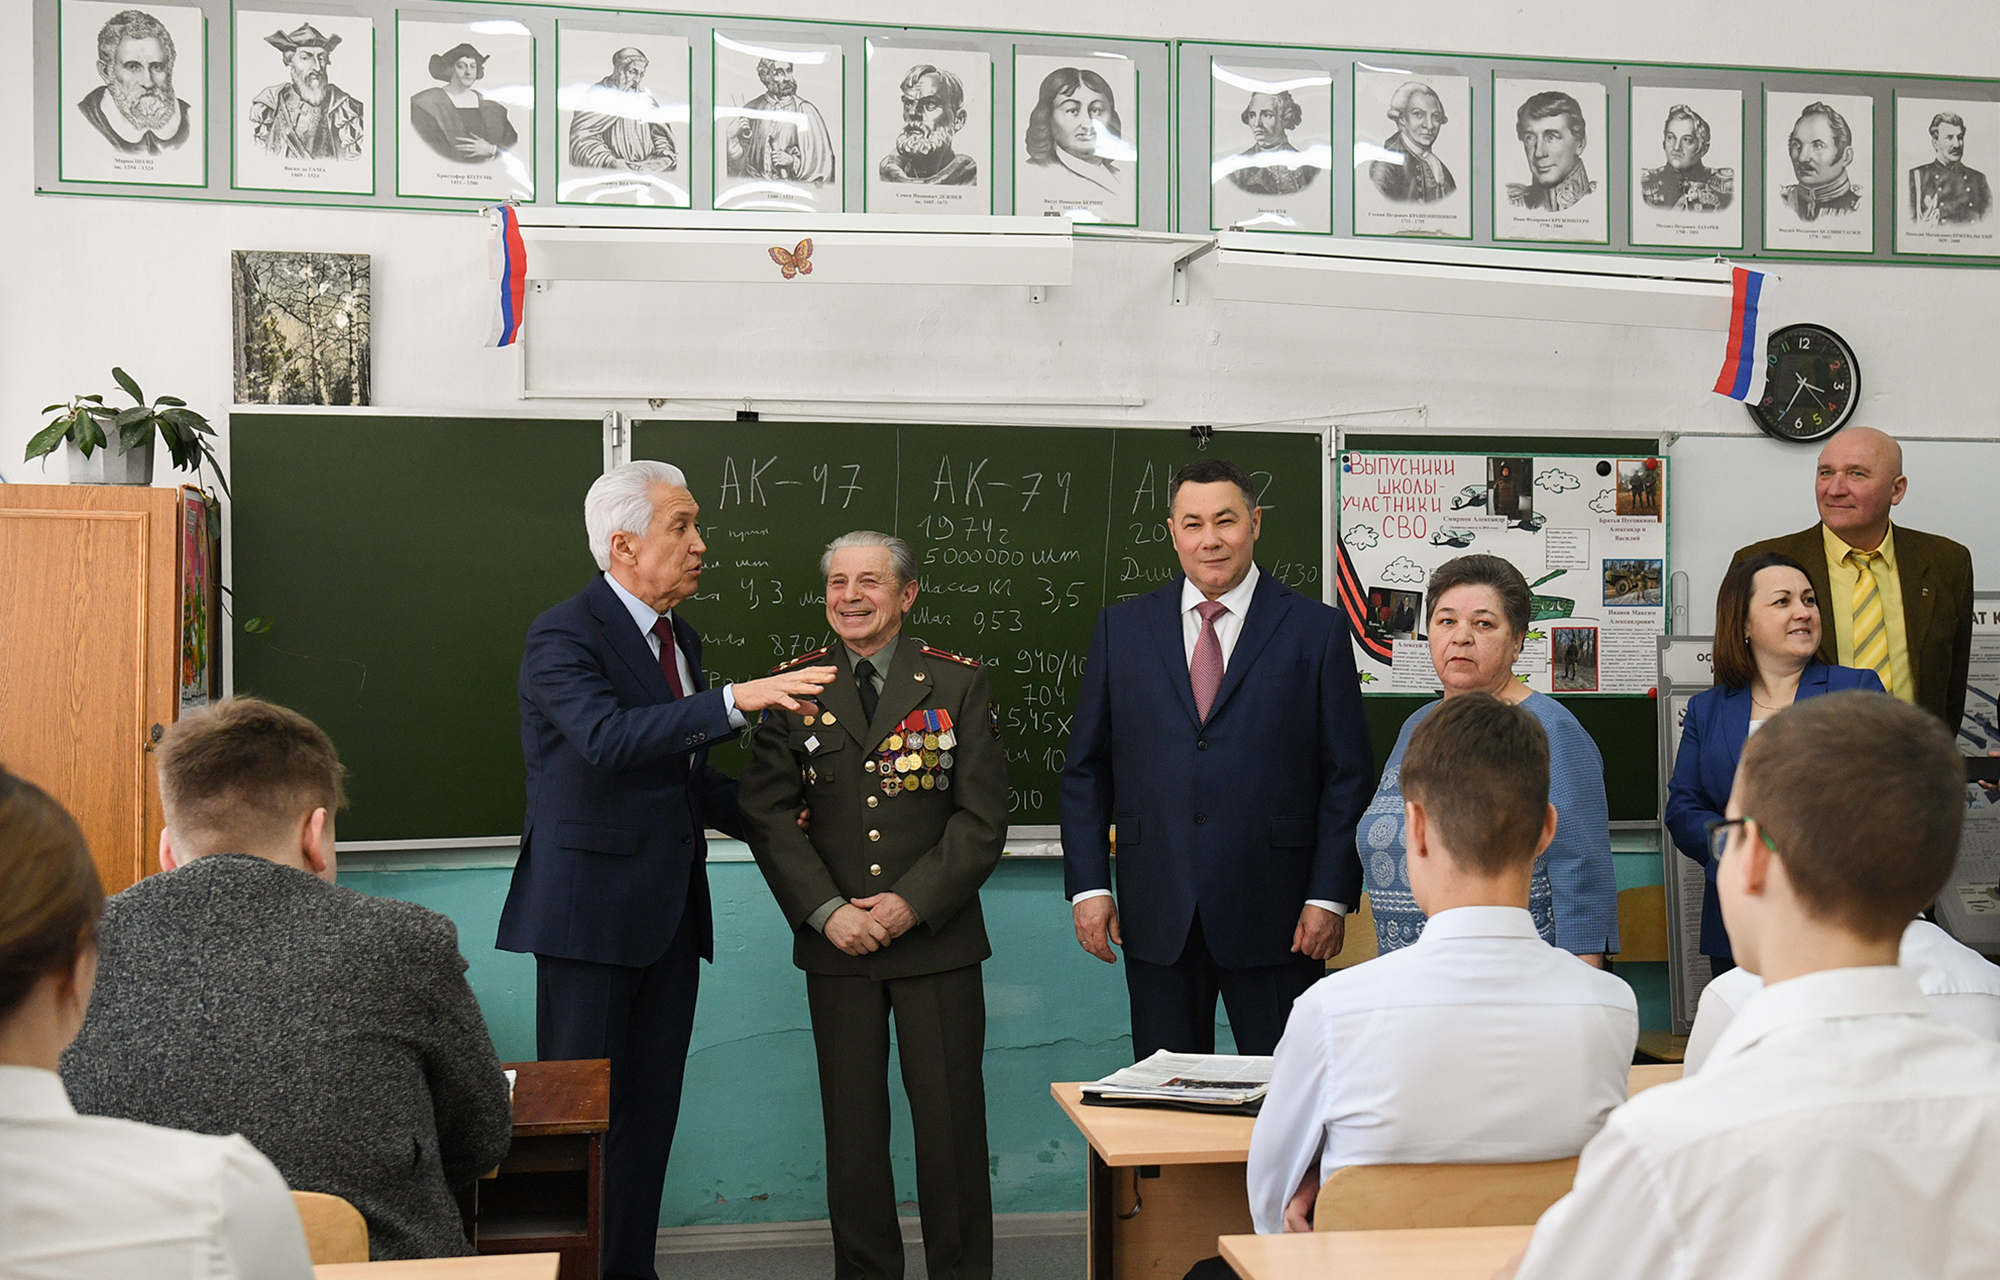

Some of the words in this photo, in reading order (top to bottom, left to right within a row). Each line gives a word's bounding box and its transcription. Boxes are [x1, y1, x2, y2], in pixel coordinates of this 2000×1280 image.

[1798, 337, 1811, 349] 12
[1829, 360, 1841, 371] 2
[1833, 382, 1845, 391] 3
[1763, 396, 1774, 406] 8
[1828, 402, 1837, 412] 4
[1777, 409, 1787, 422] 7
[1812, 413, 1823, 425] 5
[1794, 417, 1803, 429] 6
[1342, 495, 1441, 513] УЧАСТНИКИ
[1382, 514, 1427, 539] СВО
[1037, 577, 1086, 614] 3,5
